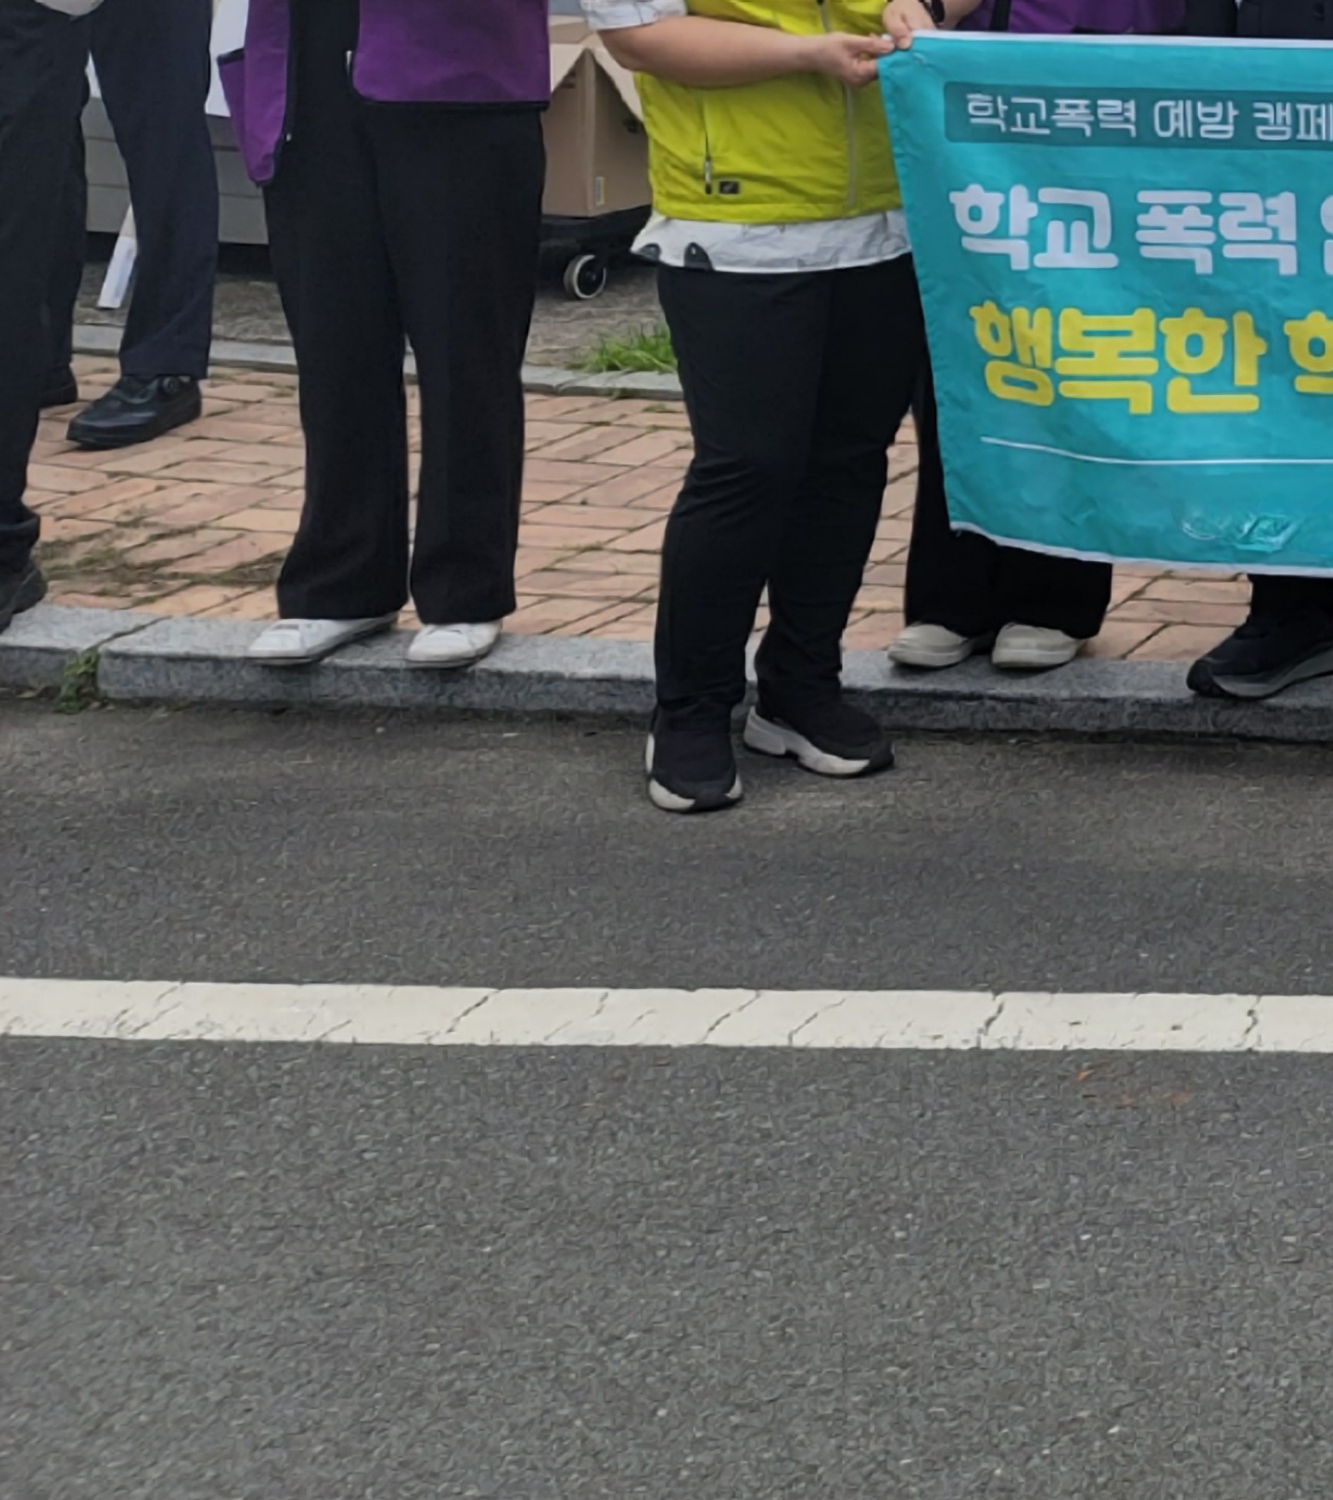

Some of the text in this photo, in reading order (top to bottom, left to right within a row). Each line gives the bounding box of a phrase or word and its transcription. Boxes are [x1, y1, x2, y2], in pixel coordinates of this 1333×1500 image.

[966, 93, 1137, 138] 학교폭력
[1153, 100, 1240, 140] 예방
[949, 182, 1119, 271] 학교
[1135, 190, 1298, 275] 폭력
[969, 300, 1267, 416] 행복한
